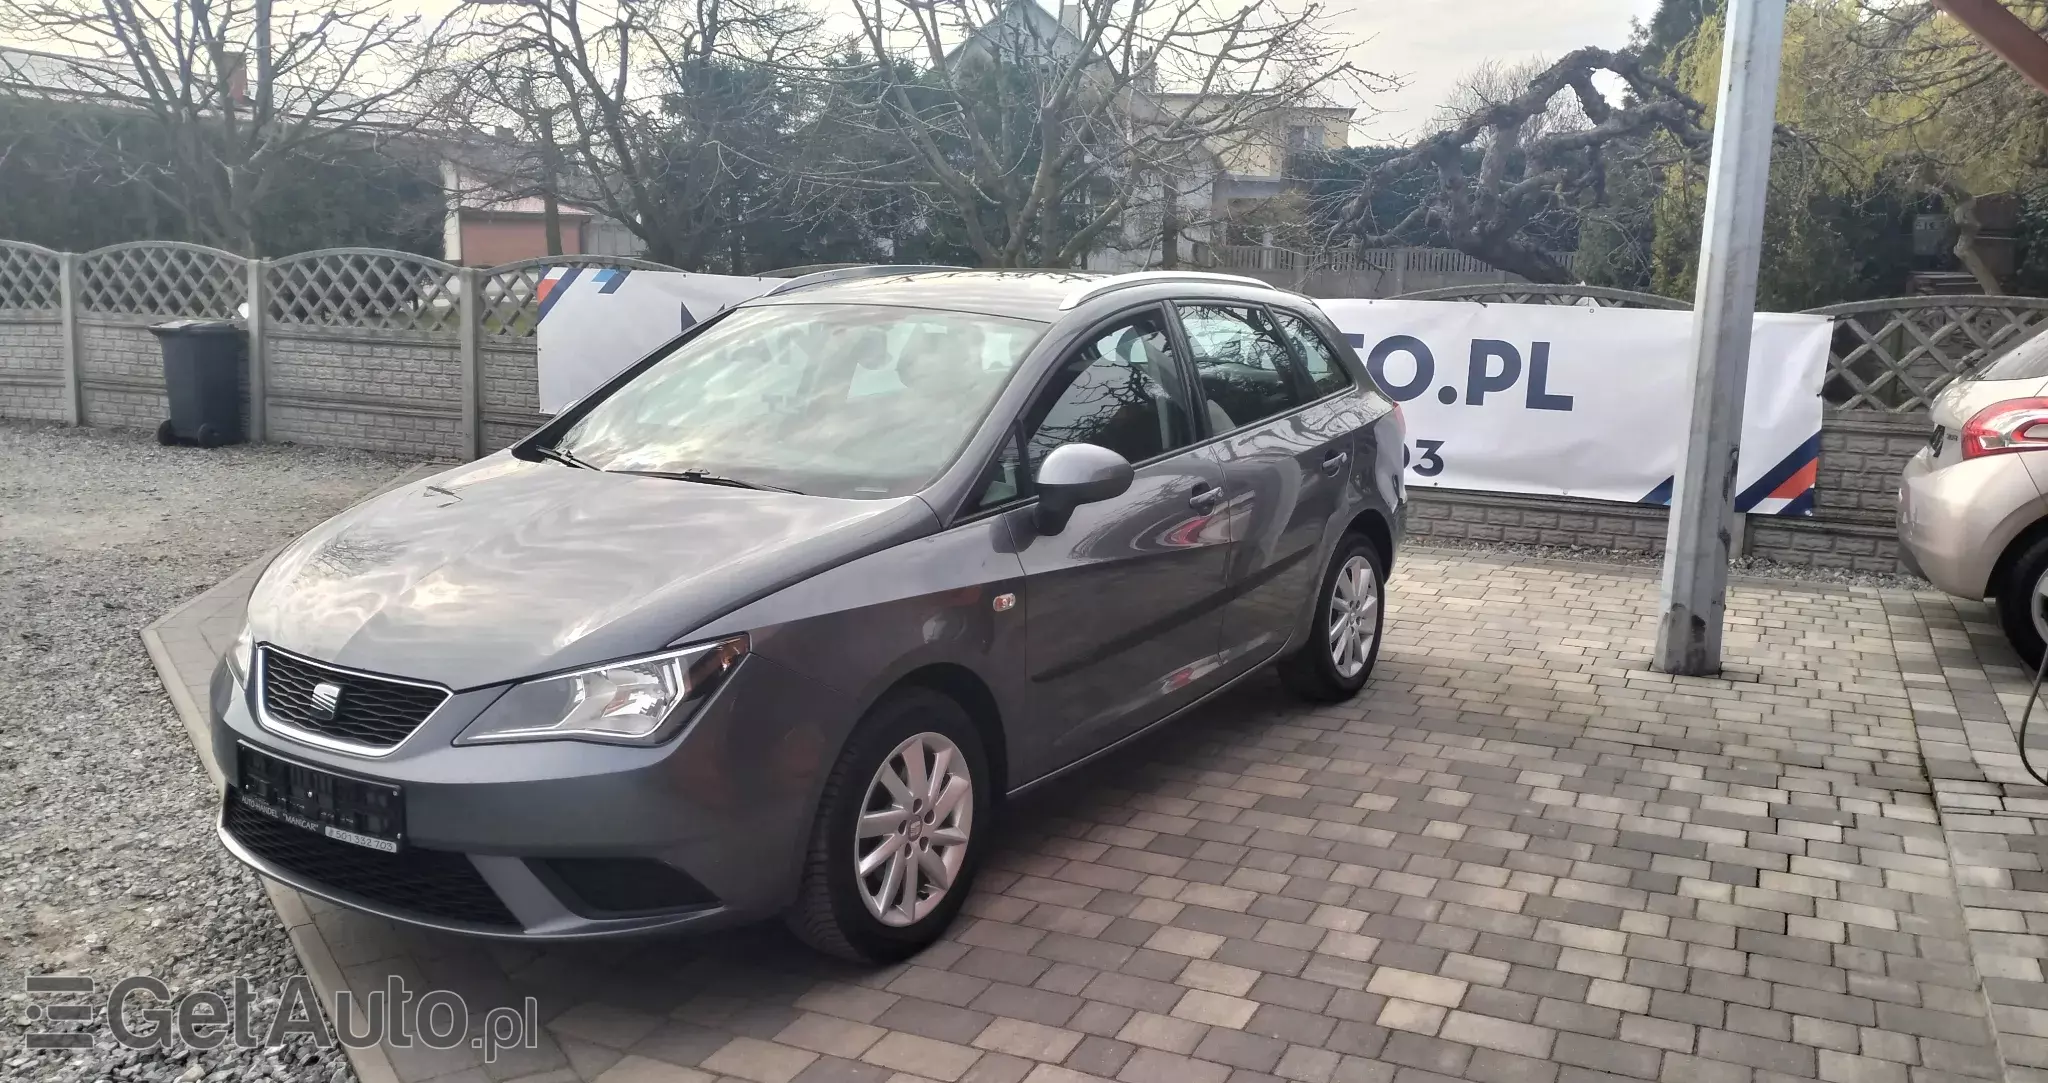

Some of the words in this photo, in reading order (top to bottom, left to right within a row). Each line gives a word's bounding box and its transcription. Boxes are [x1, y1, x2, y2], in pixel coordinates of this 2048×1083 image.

[1342, 333, 1574, 411] O.PL
[241, 795, 279, 819] AUTO-HANDEL
[335, 830, 352, 842] 501
[354, 835, 372, 847] 332
[374, 840, 393, 851] 703
